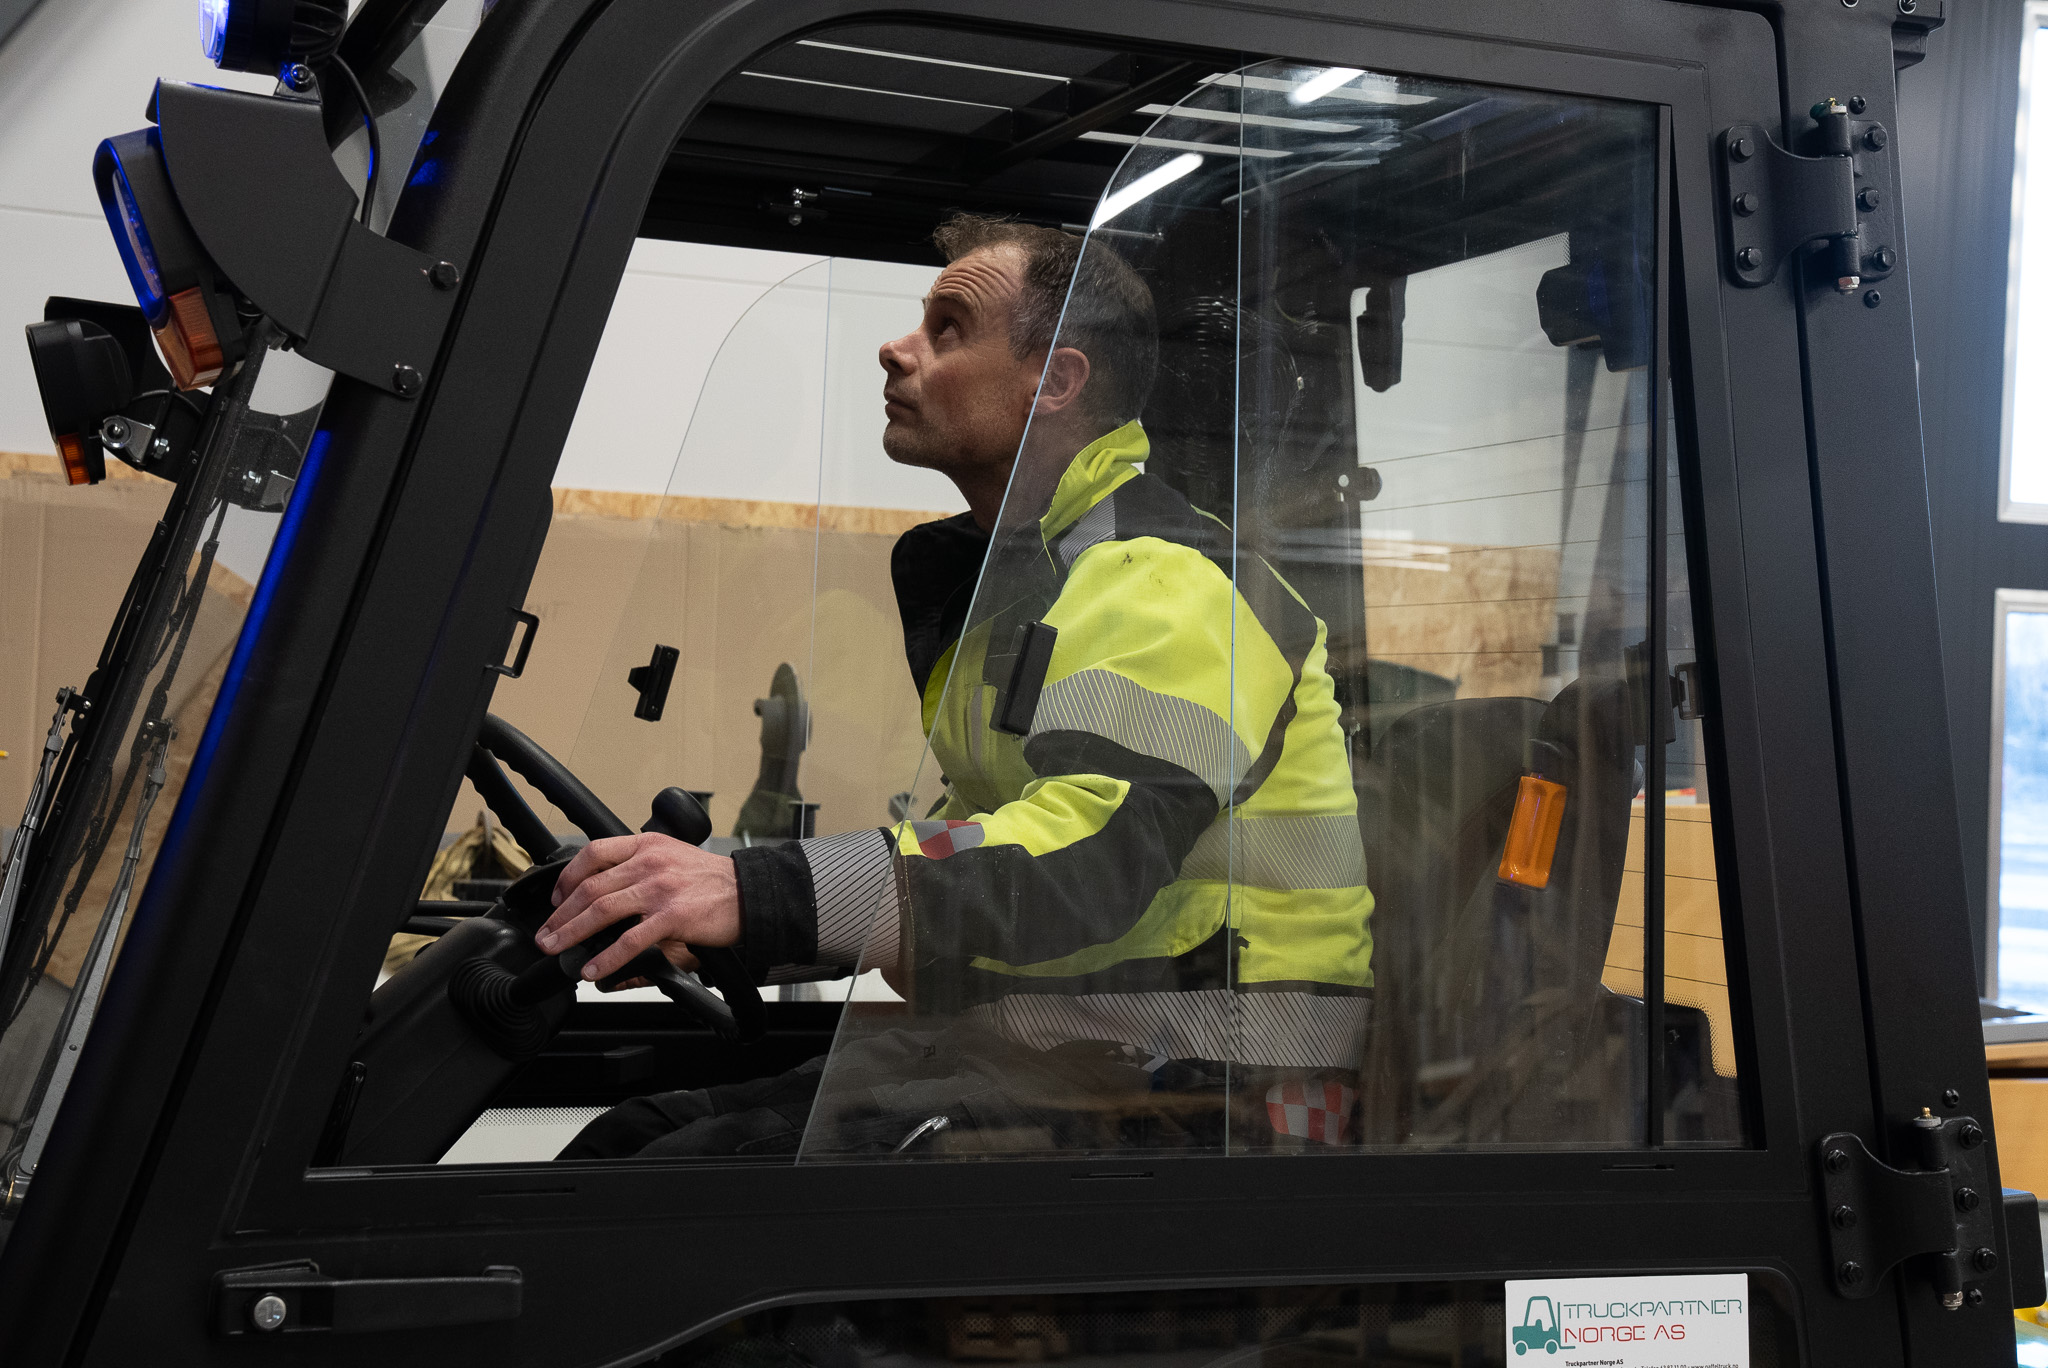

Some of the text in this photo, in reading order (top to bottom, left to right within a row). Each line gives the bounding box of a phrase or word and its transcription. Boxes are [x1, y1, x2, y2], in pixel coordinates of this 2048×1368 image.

[1563, 1298, 1742, 1319] TRUCKPARTNER
[1564, 1324, 1686, 1343] NORGE AS
[1599, 1359, 1616, 1367] Norge
